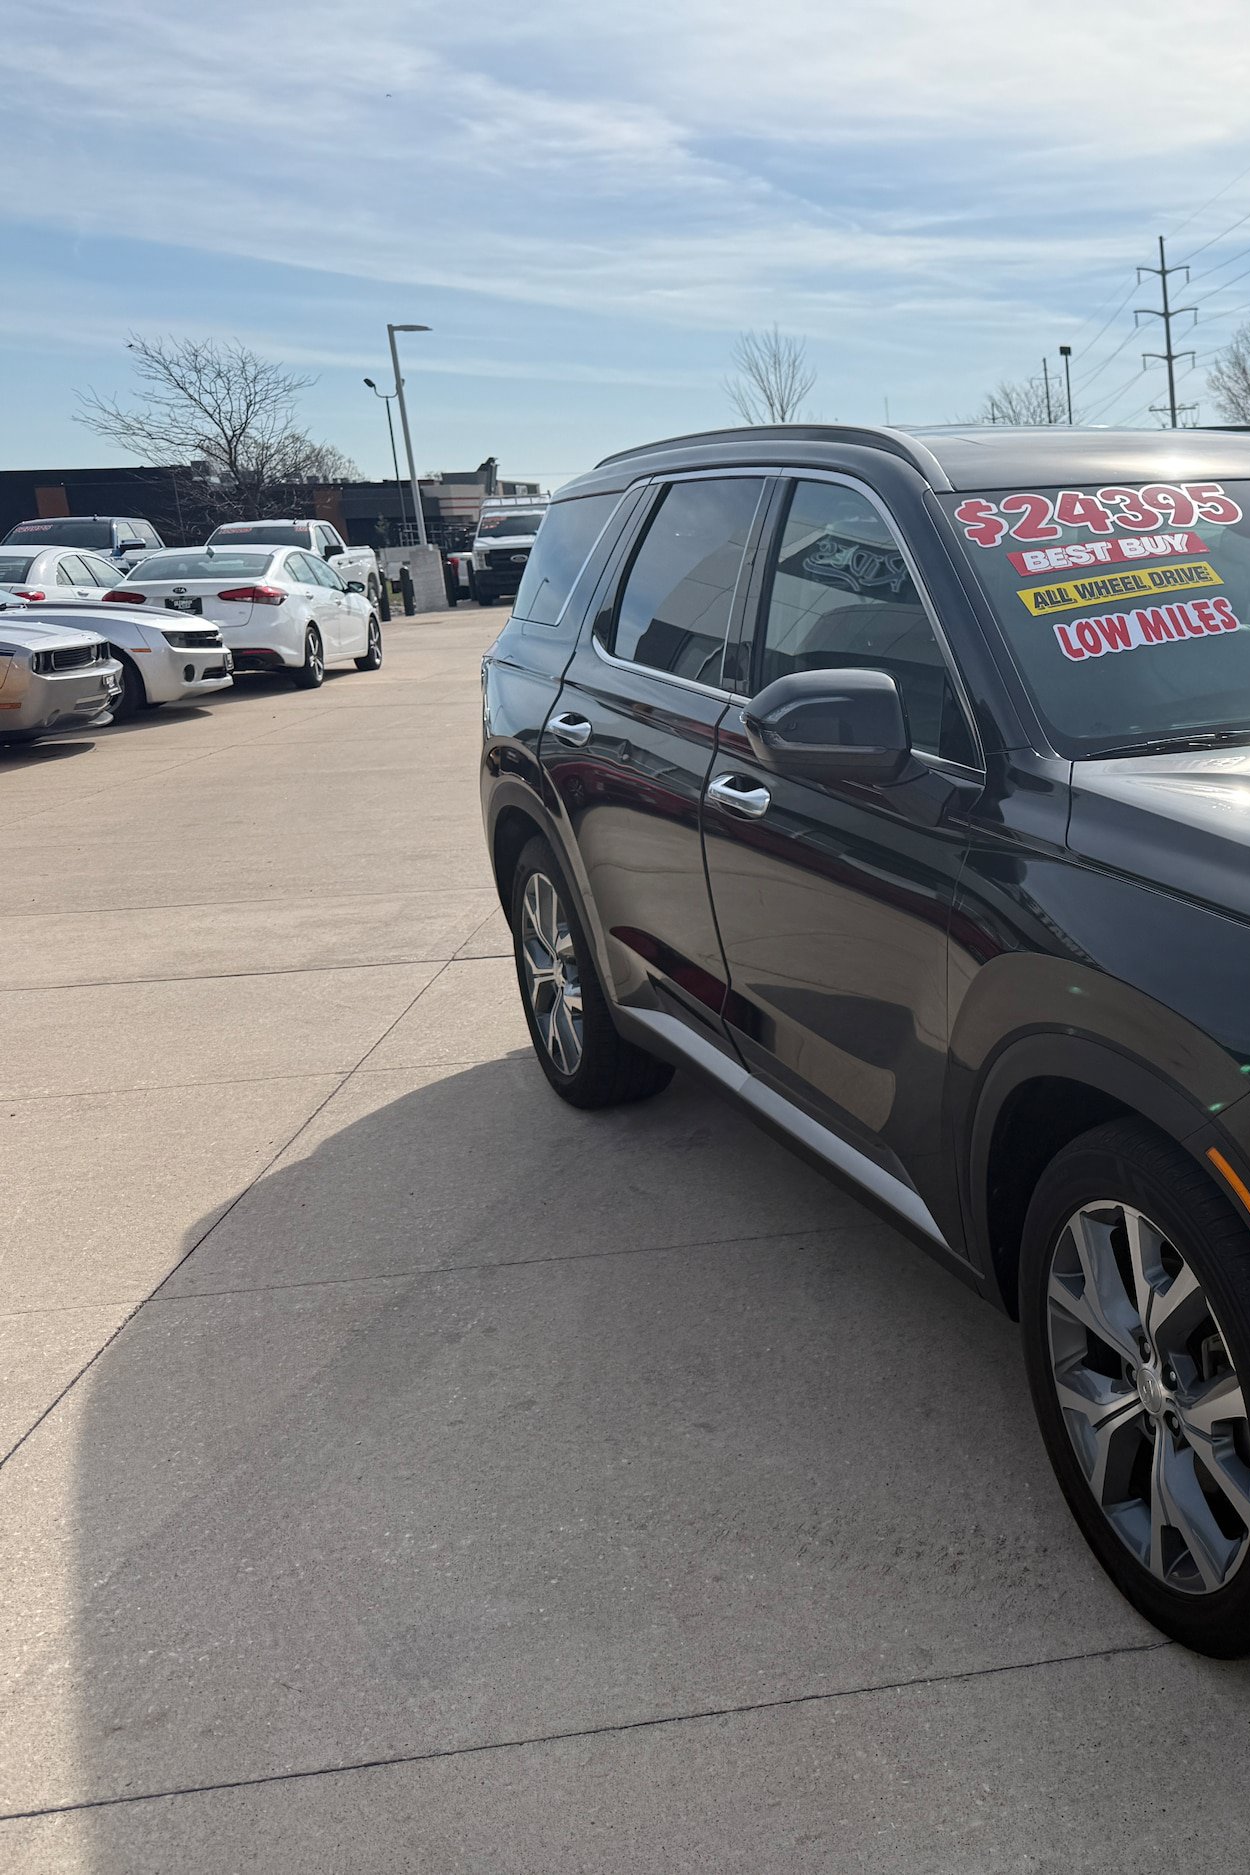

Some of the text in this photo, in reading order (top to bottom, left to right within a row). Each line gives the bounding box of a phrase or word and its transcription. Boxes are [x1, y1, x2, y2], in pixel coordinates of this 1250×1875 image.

[955, 484, 1242, 547] $24395
[1022, 533, 1189, 572] BEST BUY
[1033, 566, 1211, 610] ALL WHEEL DRIVE
[1056, 598, 1238, 660] LOW MILES
